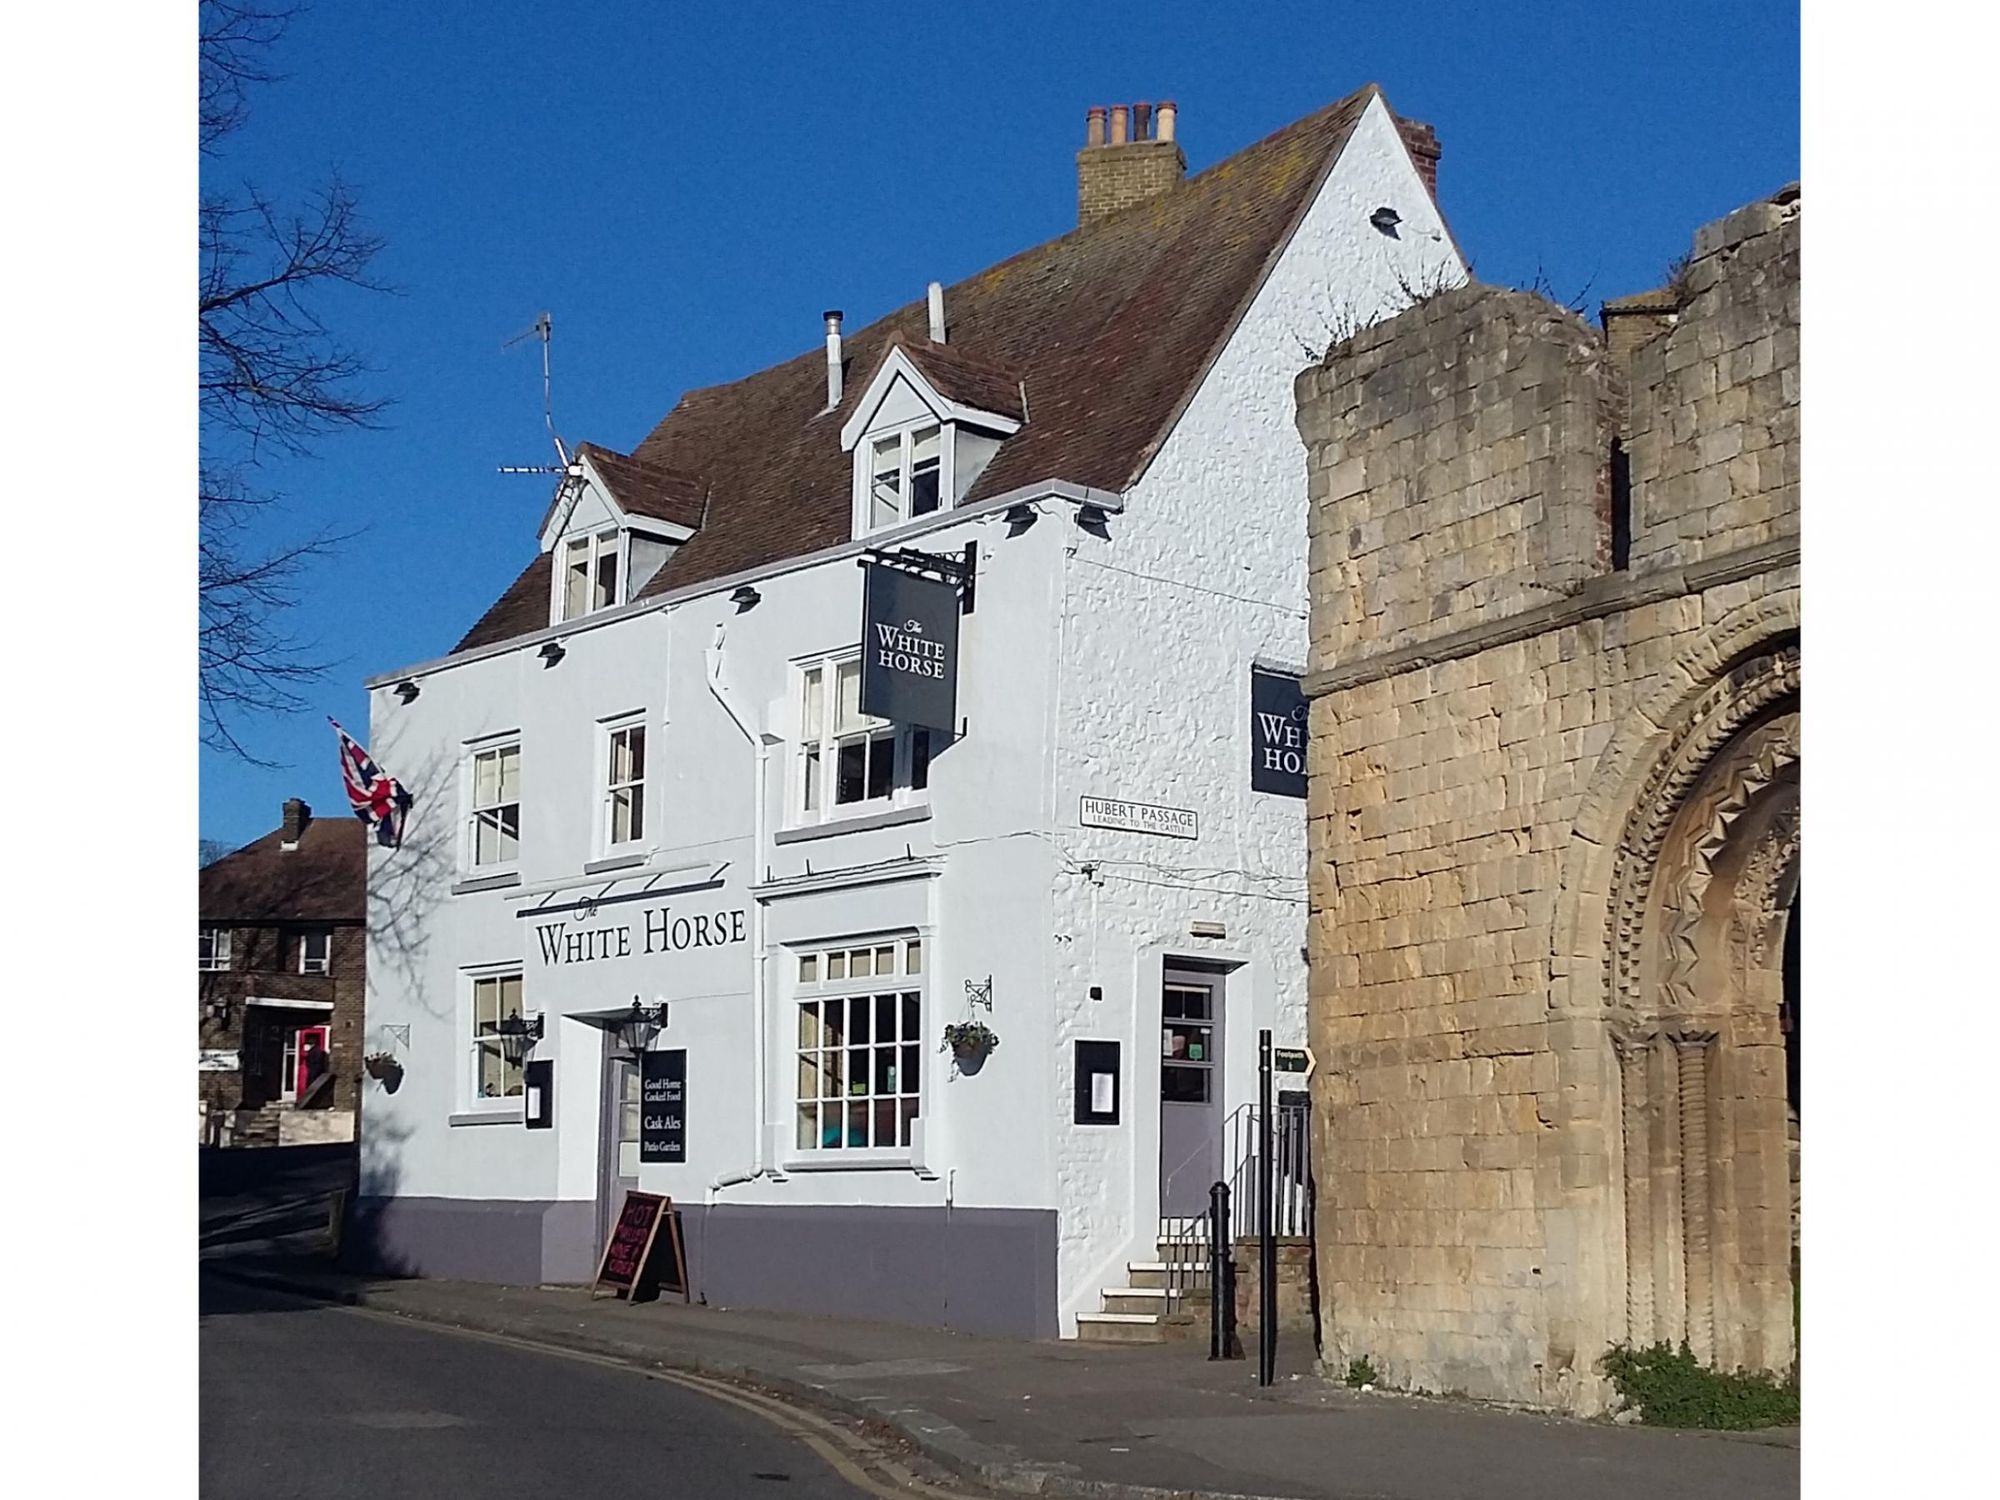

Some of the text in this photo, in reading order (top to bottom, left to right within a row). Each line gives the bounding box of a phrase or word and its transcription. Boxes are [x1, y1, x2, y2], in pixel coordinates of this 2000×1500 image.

[903, 619, 922, 634] The
[875, 622, 945, 660] WHITE
[878, 649, 945, 679] HORSE
[1085, 800, 1193, 827] HUBERT PASSAGE
[1093, 815, 1185, 835] LEADING TO THE CASTLE
[536, 907, 747, 966] WHITE HORSE
[644, 1078, 682, 1090] Good Home
[644, 1091, 681, 1102] Cooked Food
[644, 1115, 682, 1130] Cask Ales
[660, 1141, 681, 1151] Garden
[624, 1205, 655, 1226] HOT
